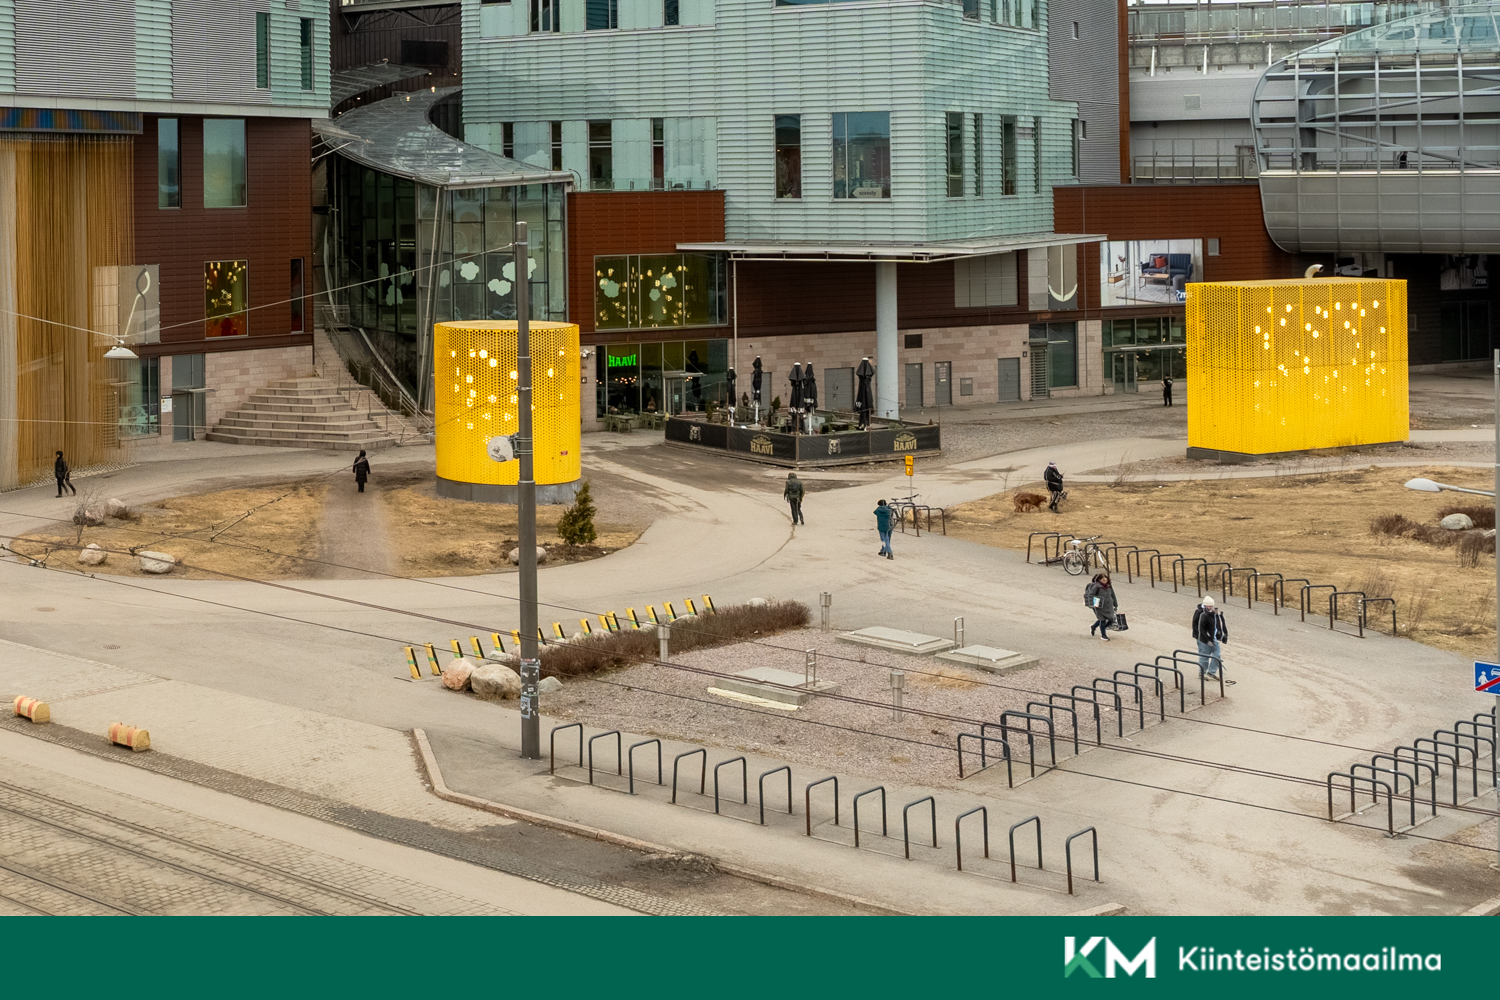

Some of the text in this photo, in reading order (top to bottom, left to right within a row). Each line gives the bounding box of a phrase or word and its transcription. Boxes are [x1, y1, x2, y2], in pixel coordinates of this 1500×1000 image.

[608, 354, 636, 367] HAAVI
[750, 440, 774, 455] HAAVI
[893, 438, 917, 451] HAAVI
